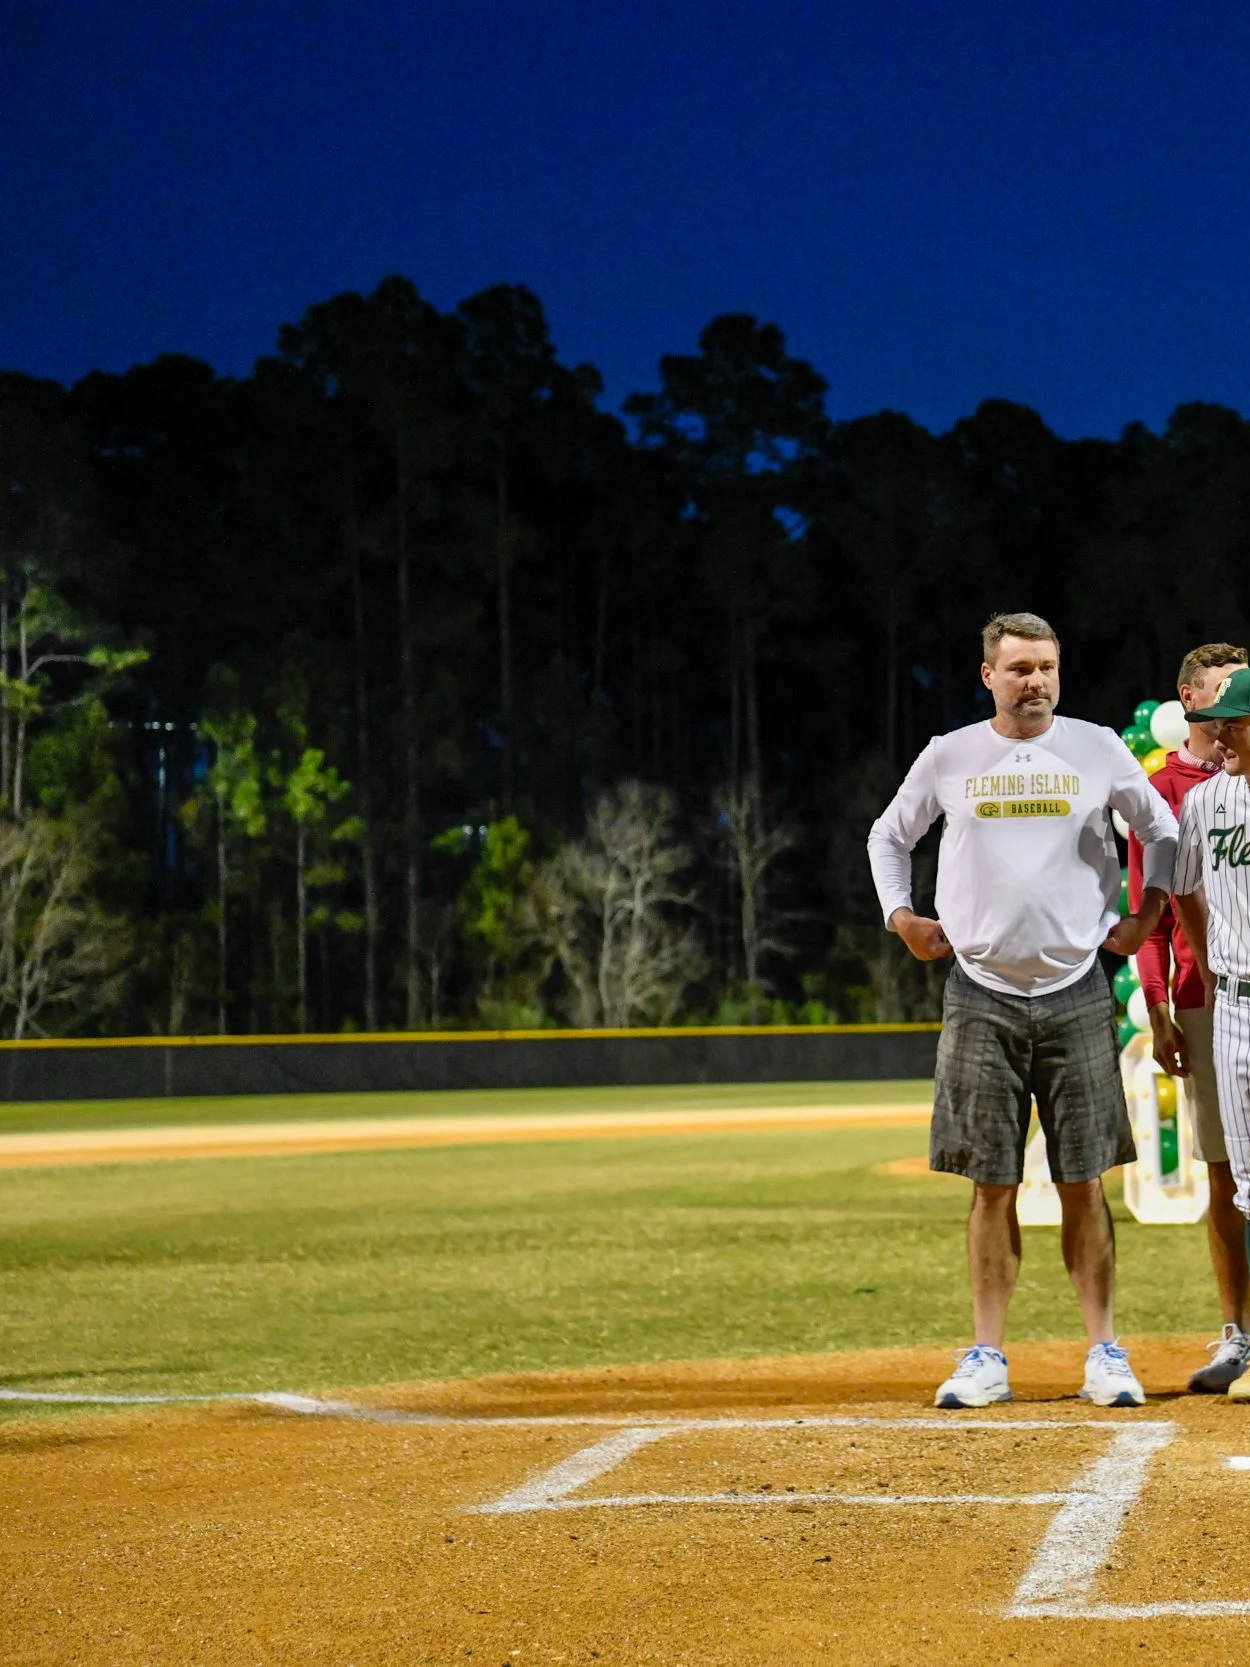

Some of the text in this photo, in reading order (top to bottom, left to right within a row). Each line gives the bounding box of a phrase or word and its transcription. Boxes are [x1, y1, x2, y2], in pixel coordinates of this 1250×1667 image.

[965, 774, 1080, 799] FLEMING ISLAND
[1011, 803, 1061, 814] BASEBALL
